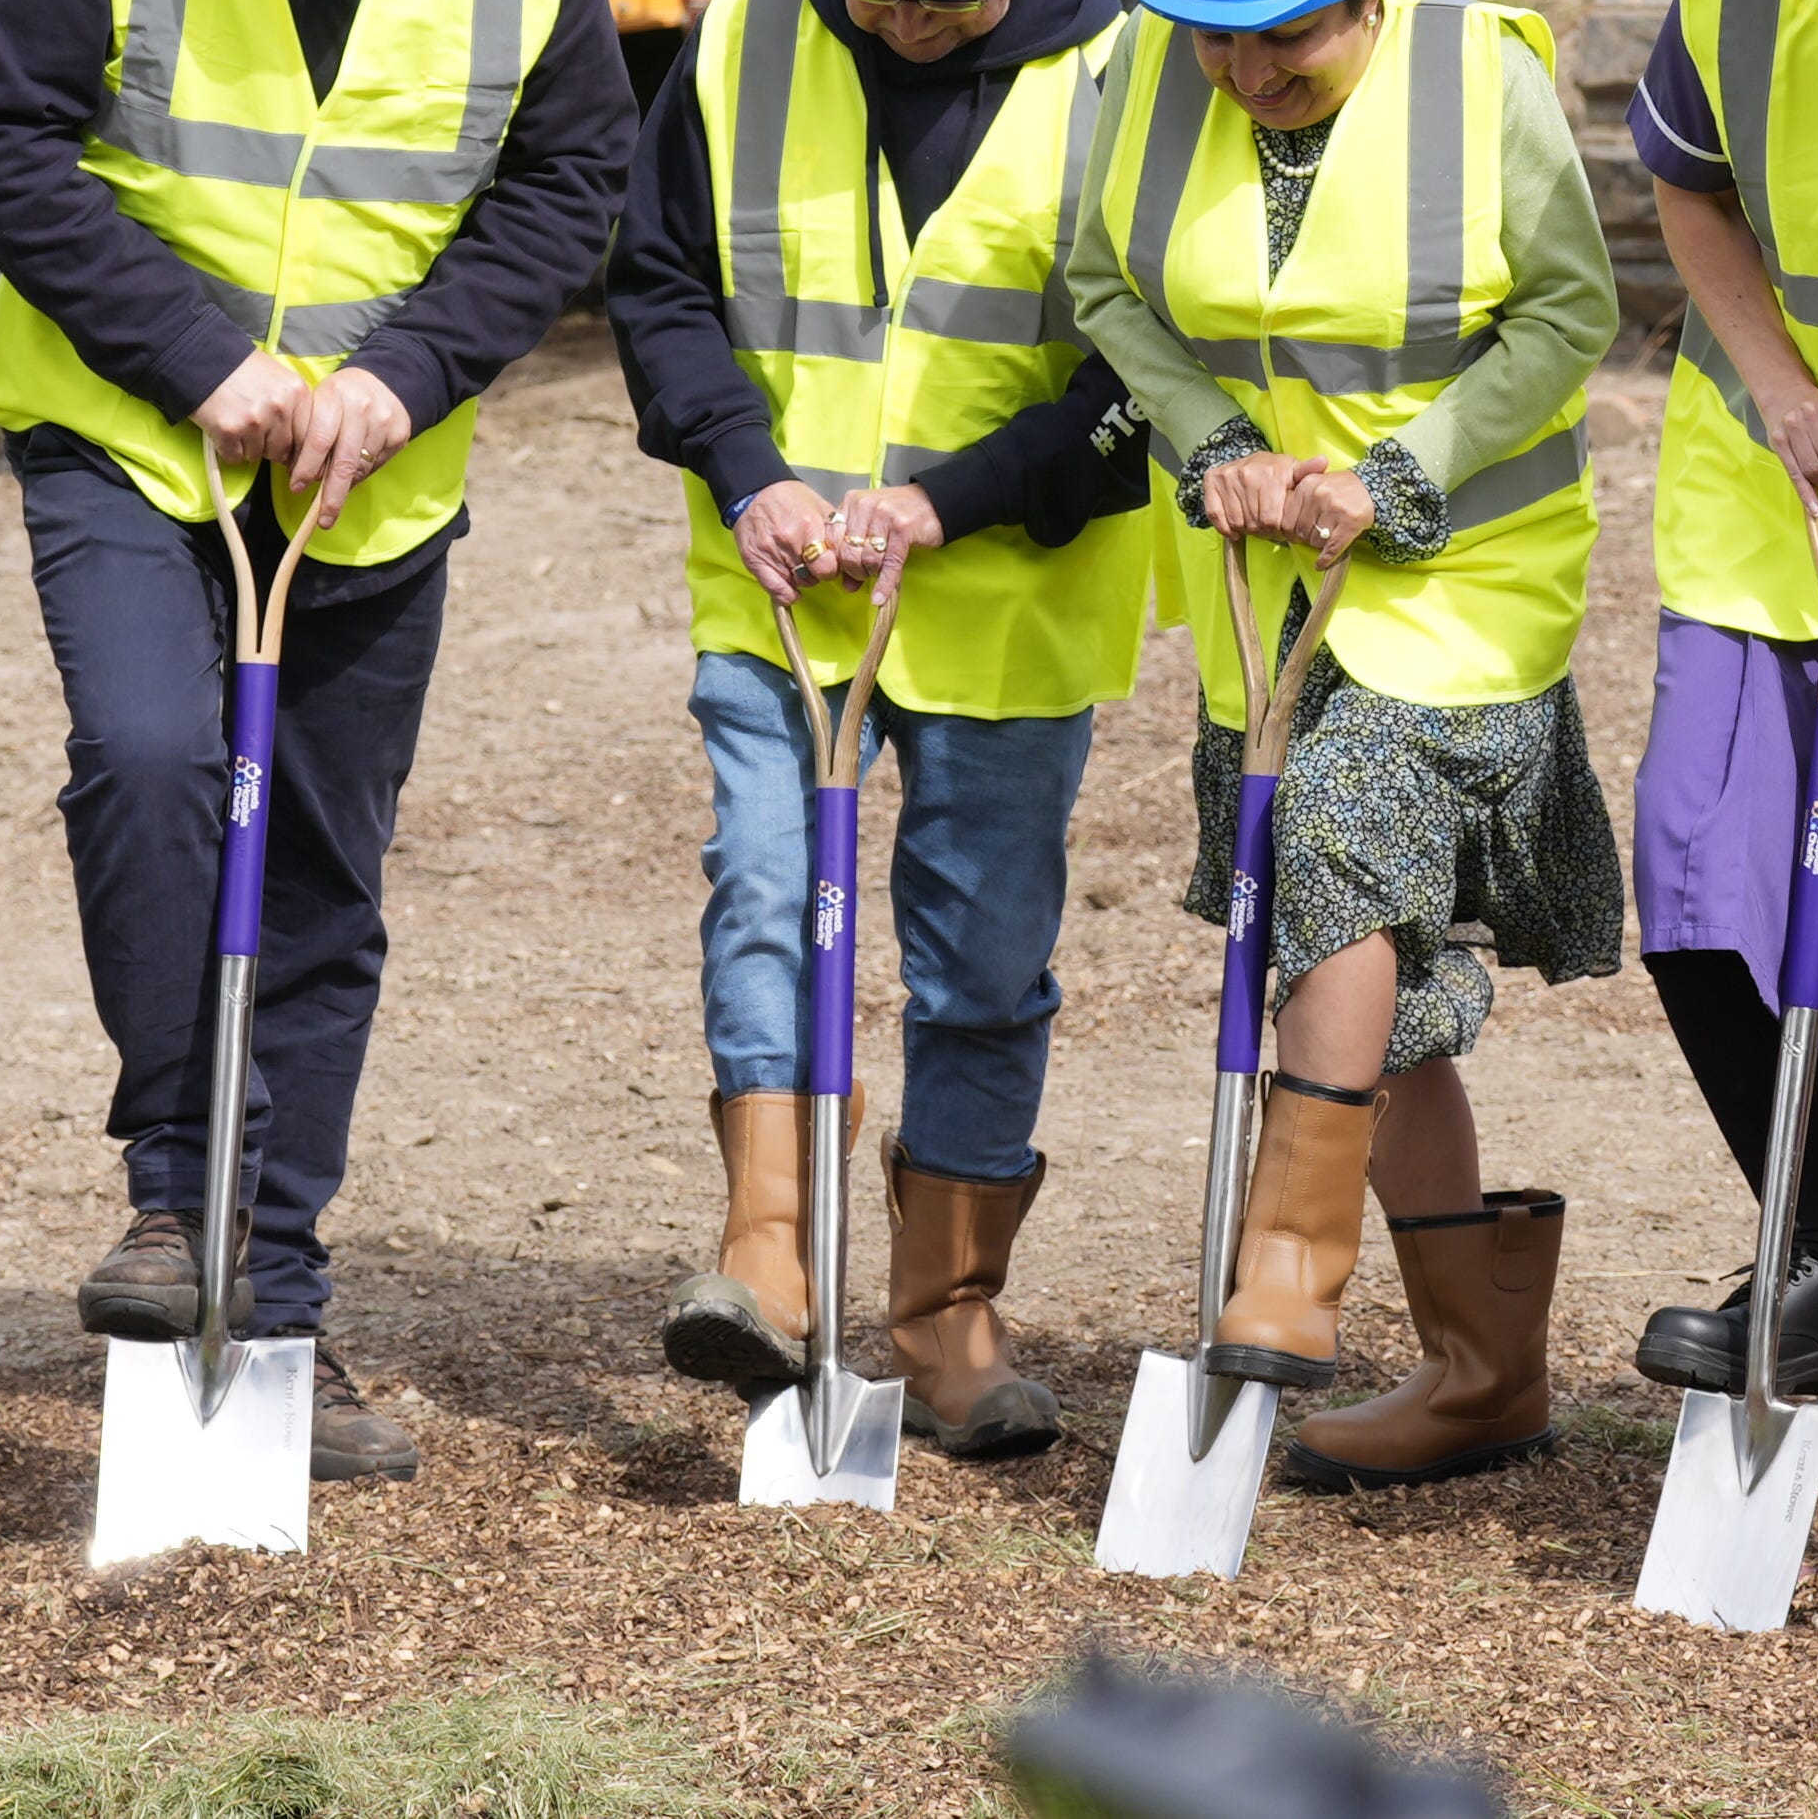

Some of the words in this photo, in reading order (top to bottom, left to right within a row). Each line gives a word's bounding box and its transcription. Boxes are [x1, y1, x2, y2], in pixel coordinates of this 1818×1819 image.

[1088, 395, 1149, 458] #Te
[231, 786, 242, 822] Charity
[239, 783, 251, 827] Hospitals
[250, 781, 261, 810] Leeds
[1803, 832, 1817, 869] Charity
[834, 904, 844, 933] Leeds
[1228, 900, 1239, 937] Charity
[1235, 898, 1246, 942] Hospitals
[1246, 895, 1257, 924] Leeds
[816, 910, 826, 946] Charity
[824, 907, 834, 951] Hospitals
[285, 1367, 298, 1400] Kent
[1797, 1439, 1812, 1475] Kent
[1785, 1483, 1803, 1523] Stowe
